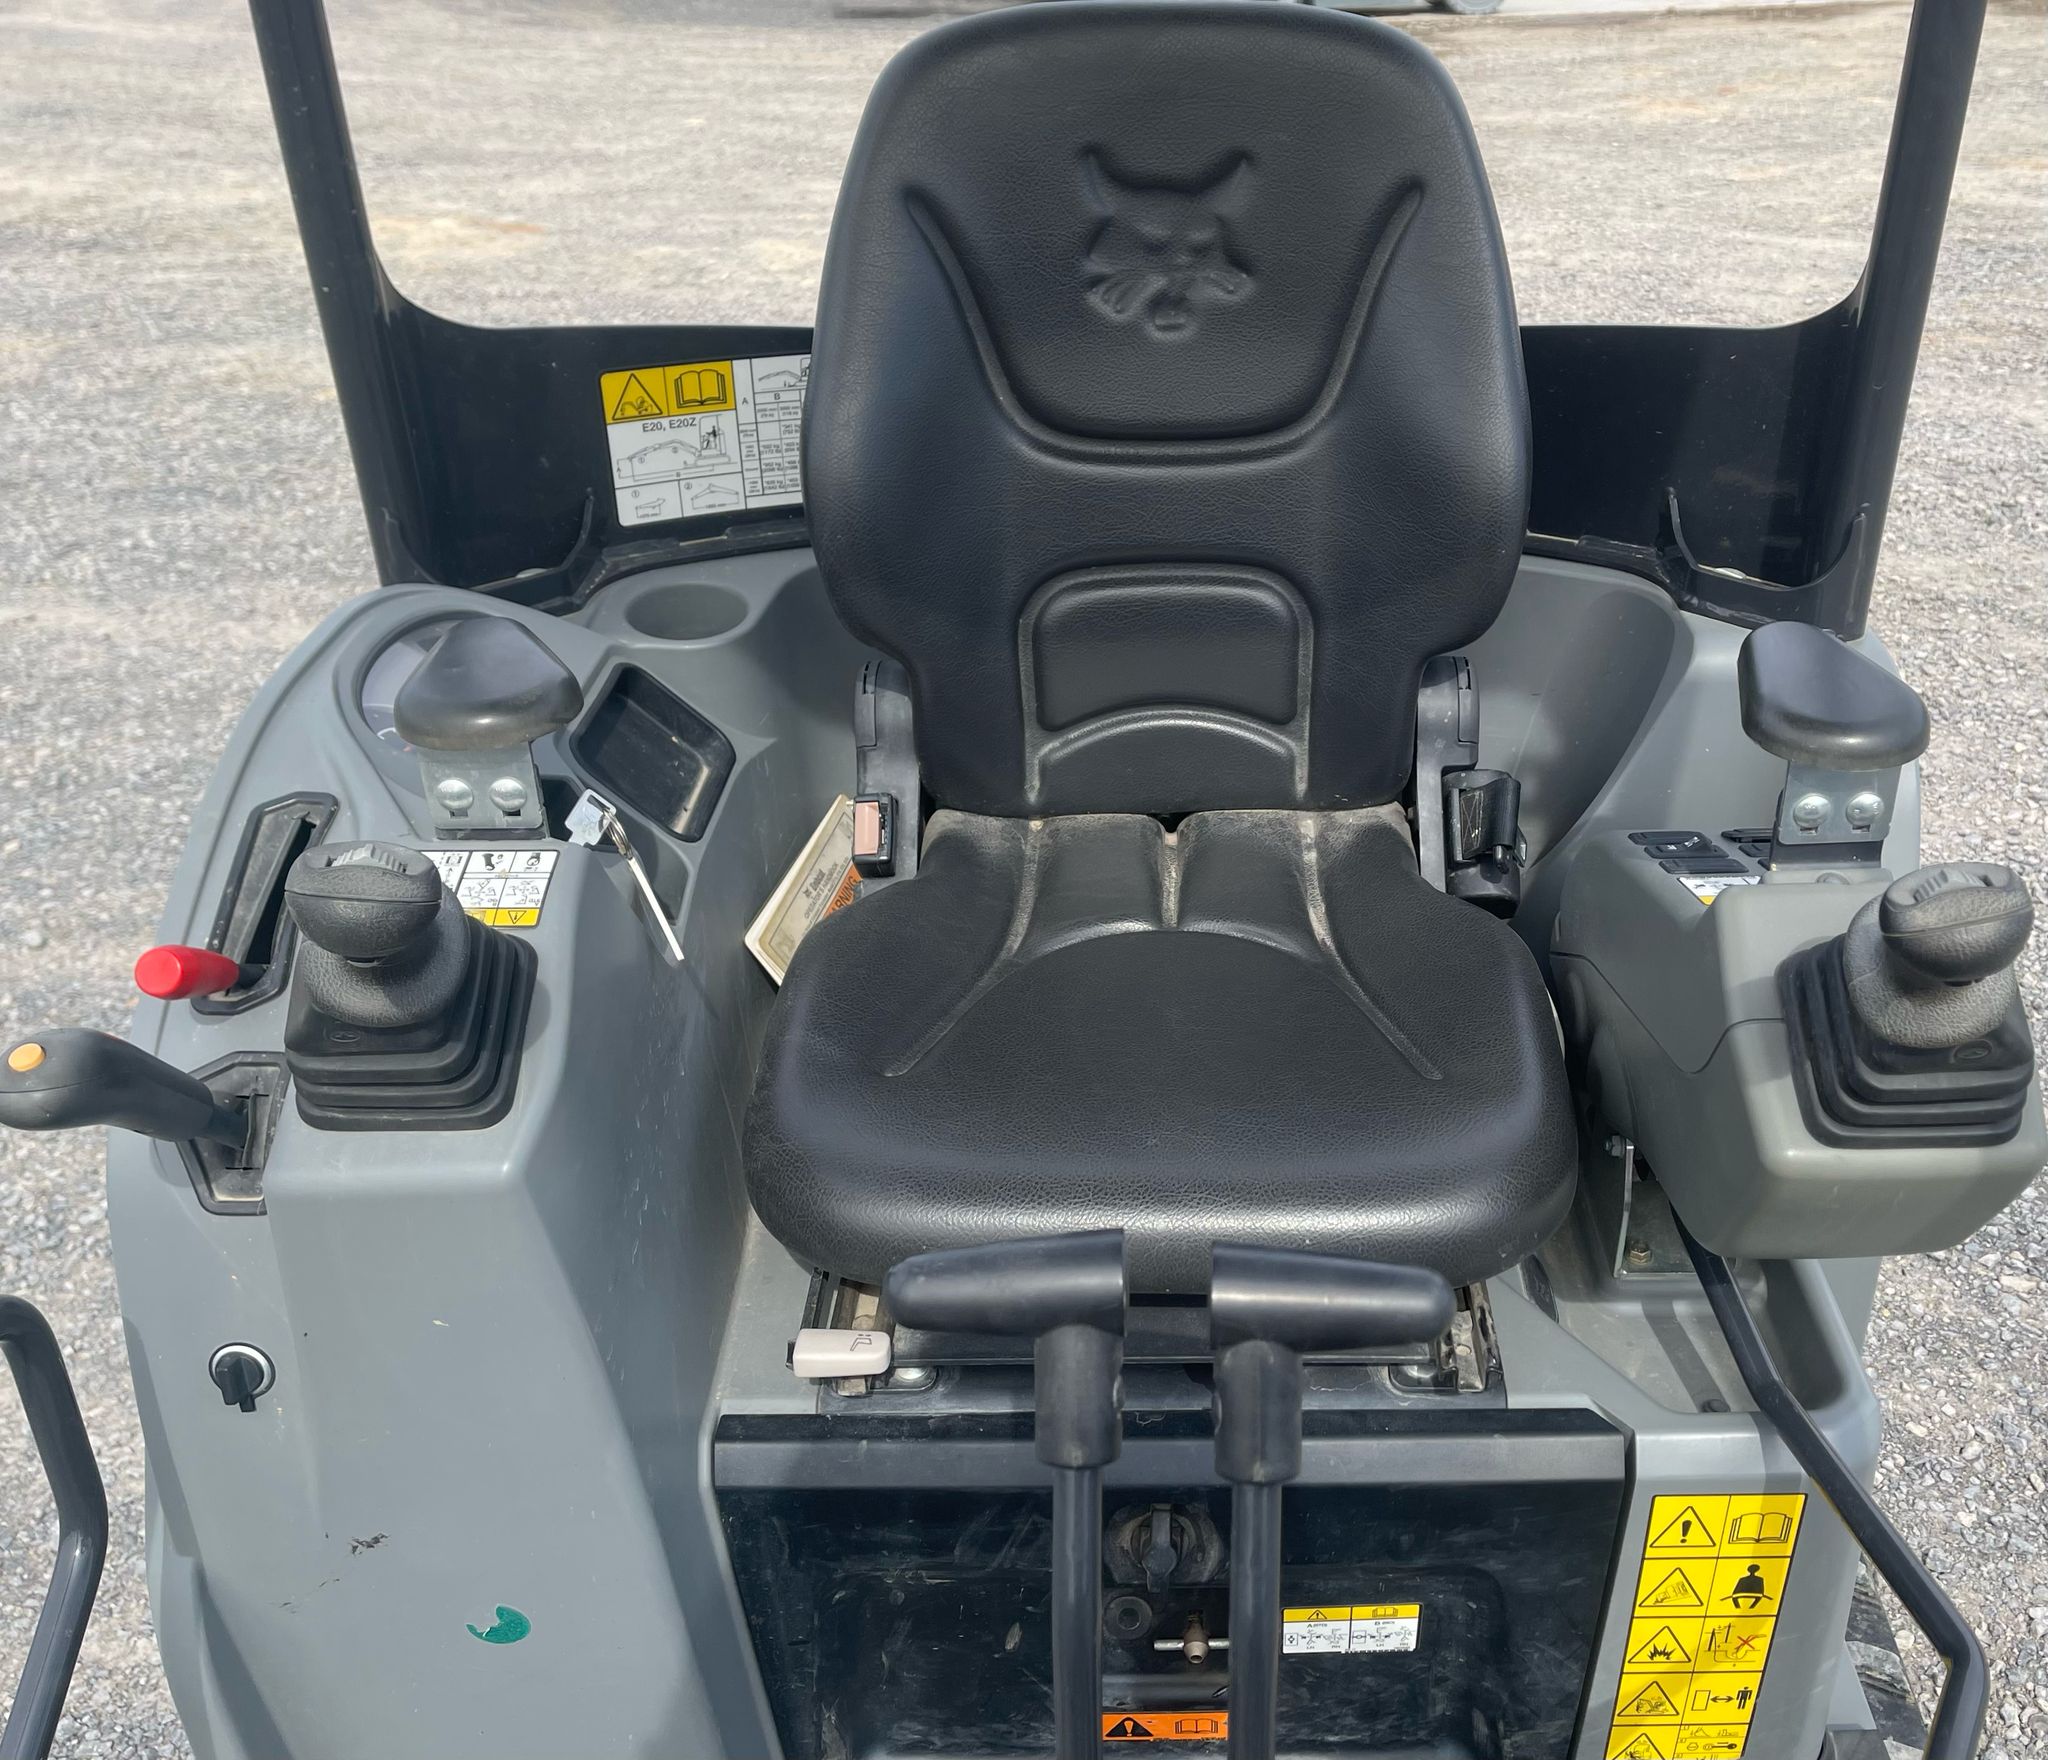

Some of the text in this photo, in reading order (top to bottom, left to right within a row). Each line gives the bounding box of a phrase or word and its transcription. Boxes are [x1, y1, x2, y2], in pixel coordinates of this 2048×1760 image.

[774, 392, 780, 400] B
[741, 397, 749, 405] A
[642, 417, 697, 432] E20, E20Z
